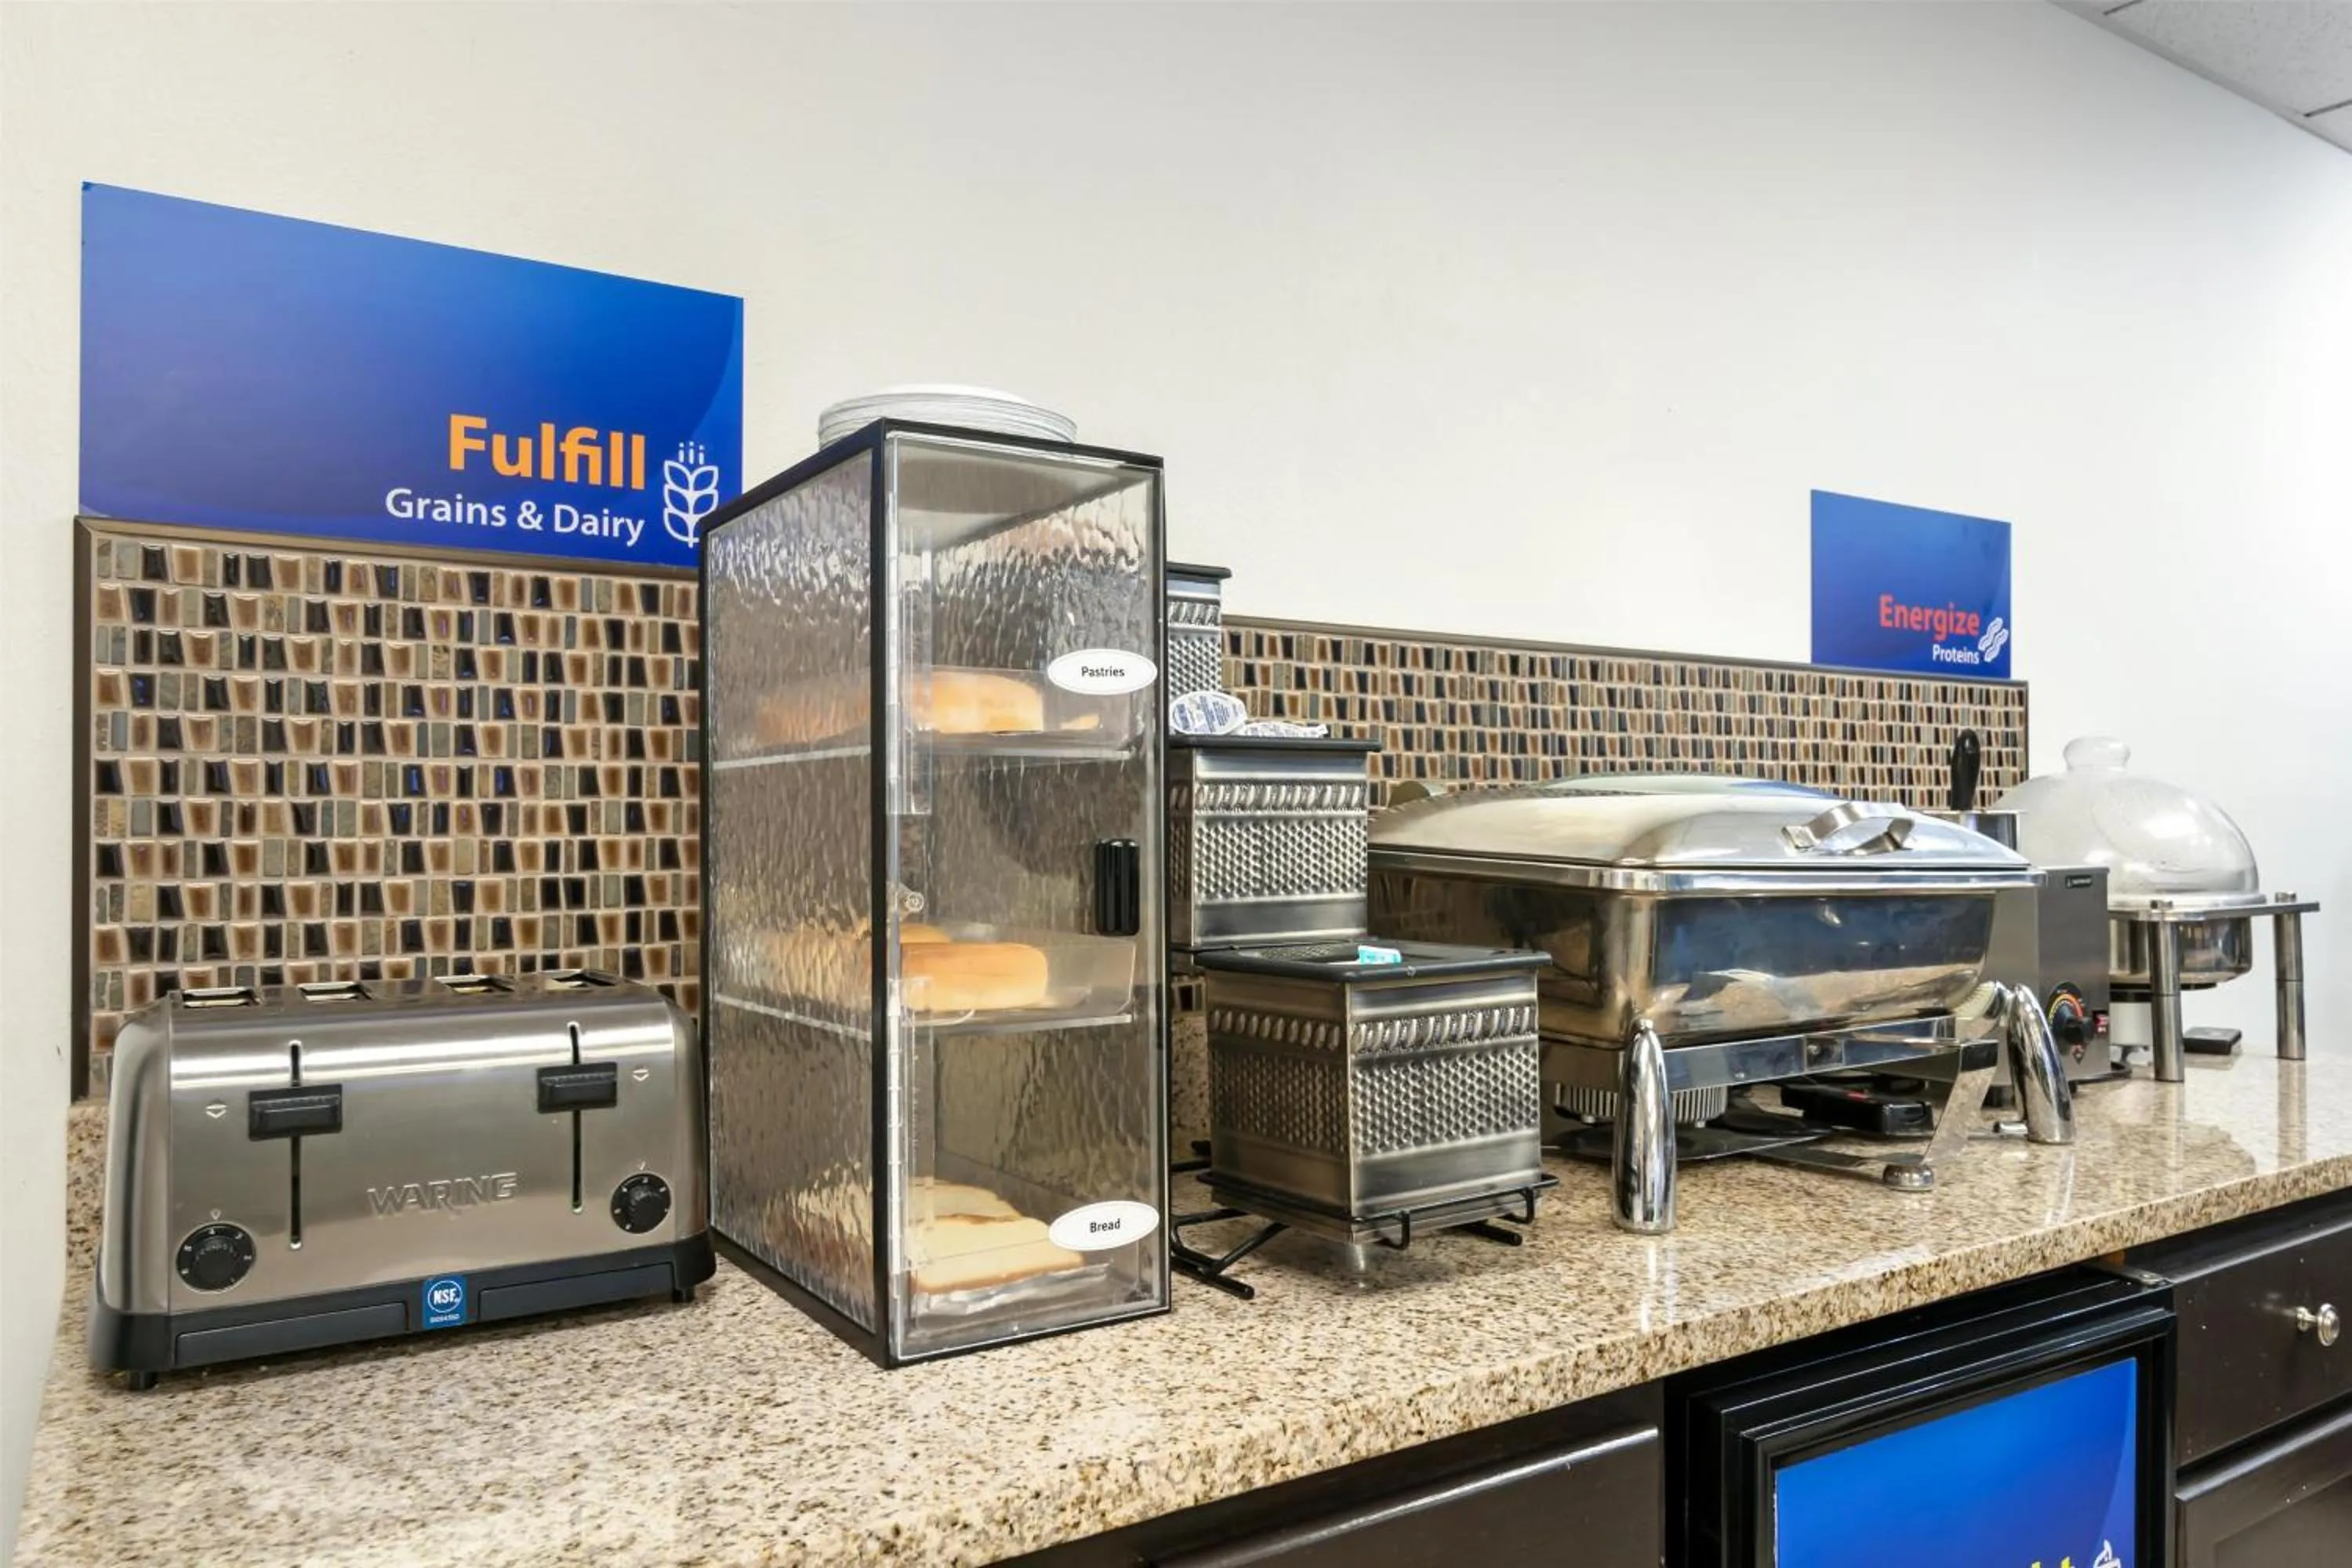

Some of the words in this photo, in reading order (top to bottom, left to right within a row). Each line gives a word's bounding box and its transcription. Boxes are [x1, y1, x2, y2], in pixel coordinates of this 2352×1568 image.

[449, 413, 646, 490] Fulfill
[385, 488, 507, 528] Grains
[517, 500, 543, 532] &
[554, 504, 645, 547] Dairy
[1878, 593, 1980, 641] Energize
[1932, 644, 1980, 665] Proteins
[1080, 666, 1126, 679] Pastries
[366, 1172, 517, 1219] WARING
[1089, 1218, 1121, 1233] Bread
[434, 1287, 457, 1305] NSF
